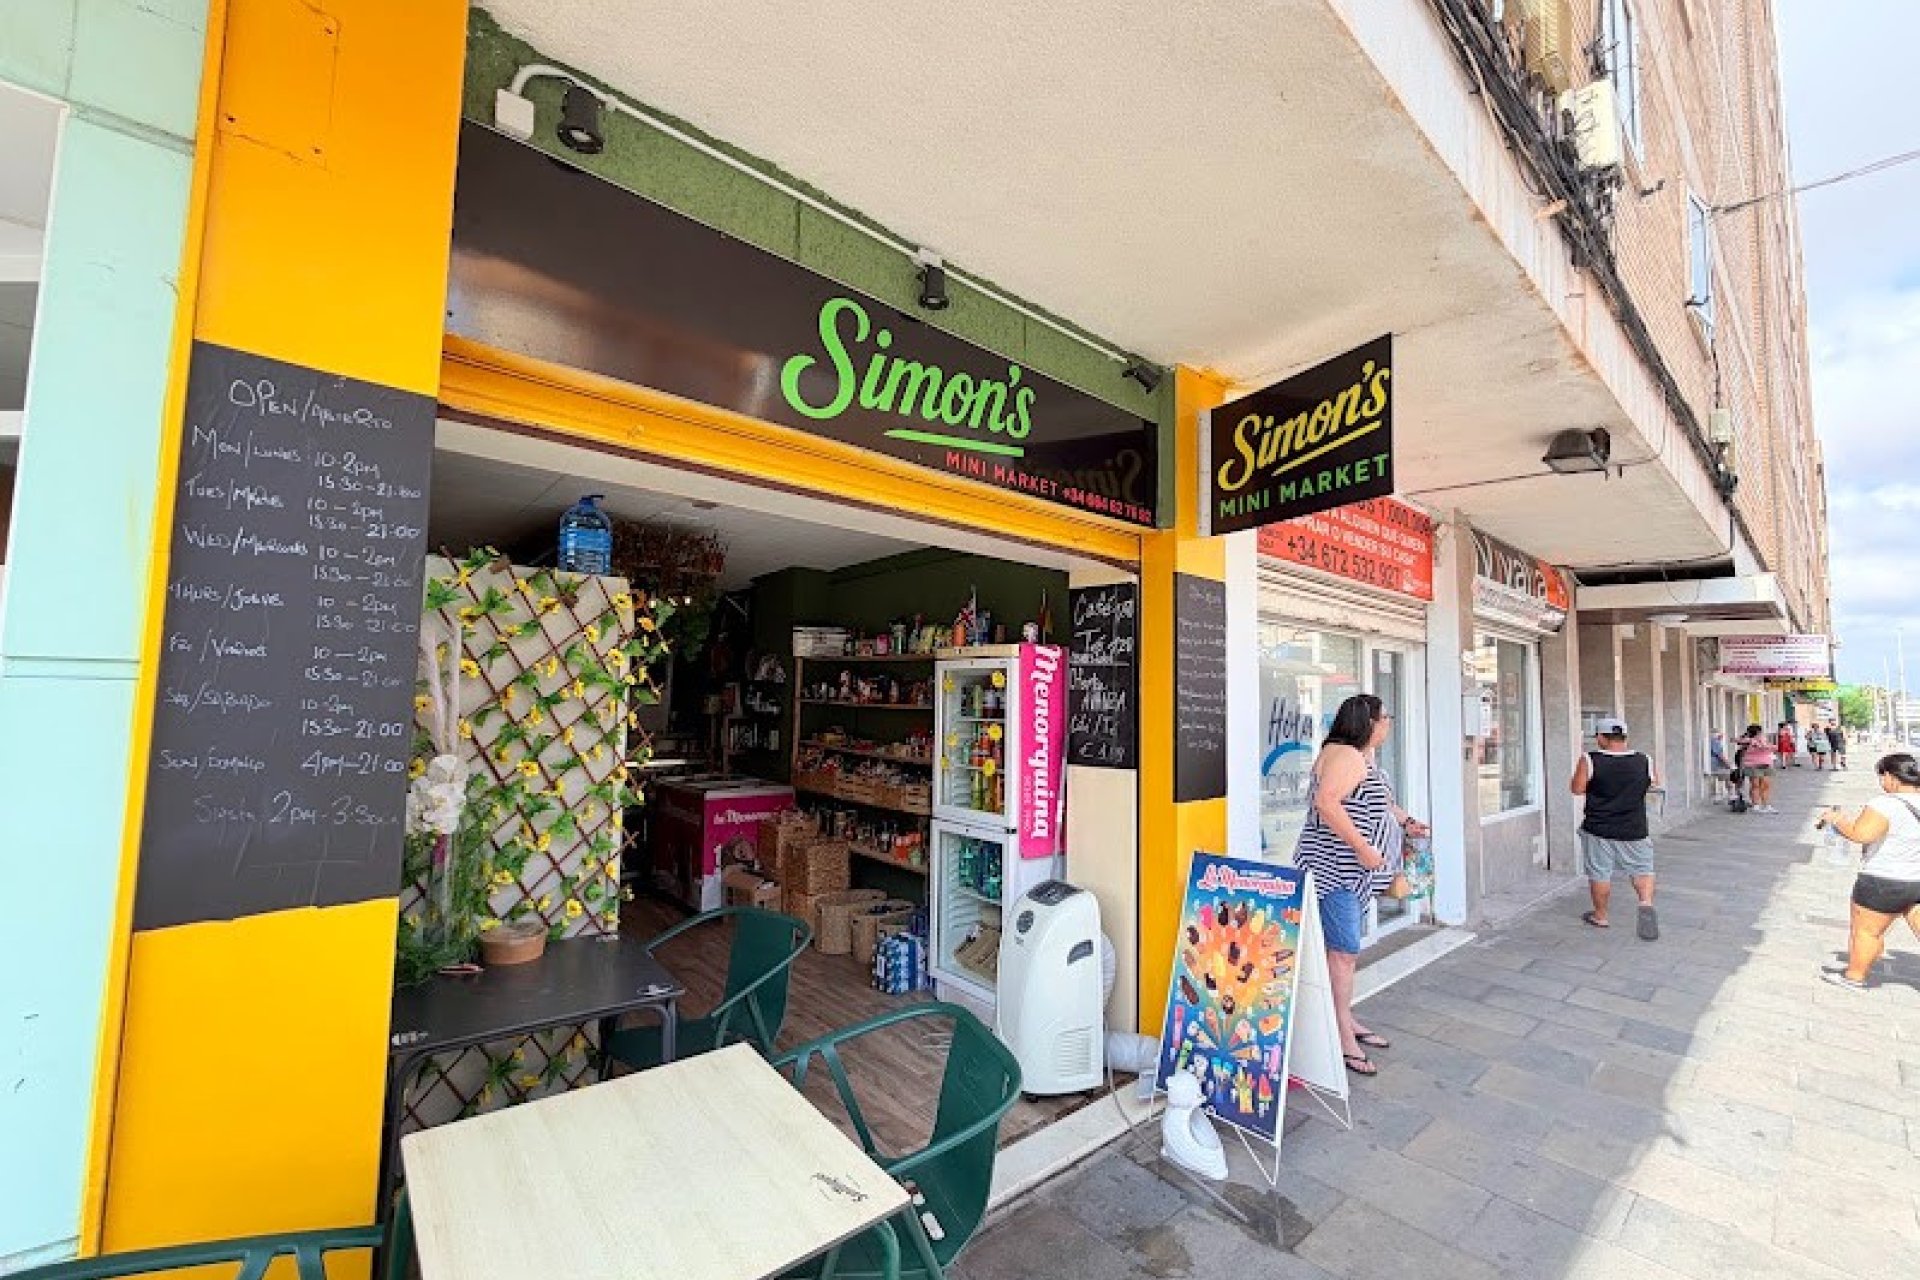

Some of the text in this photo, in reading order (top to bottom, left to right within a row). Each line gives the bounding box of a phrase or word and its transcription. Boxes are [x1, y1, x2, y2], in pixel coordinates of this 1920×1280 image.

[780, 297, 1036, 438] Simon's
[1217, 360, 1390, 491] Simon's
[946, 450, 987, 478] MINI
[994, 462, 1058, 497] MARKET
[1219, 452, 1390, 519] MINI MARKET
[1287, 535, 1317, 563] +34
[1321, 542, 1350, 575] 672
